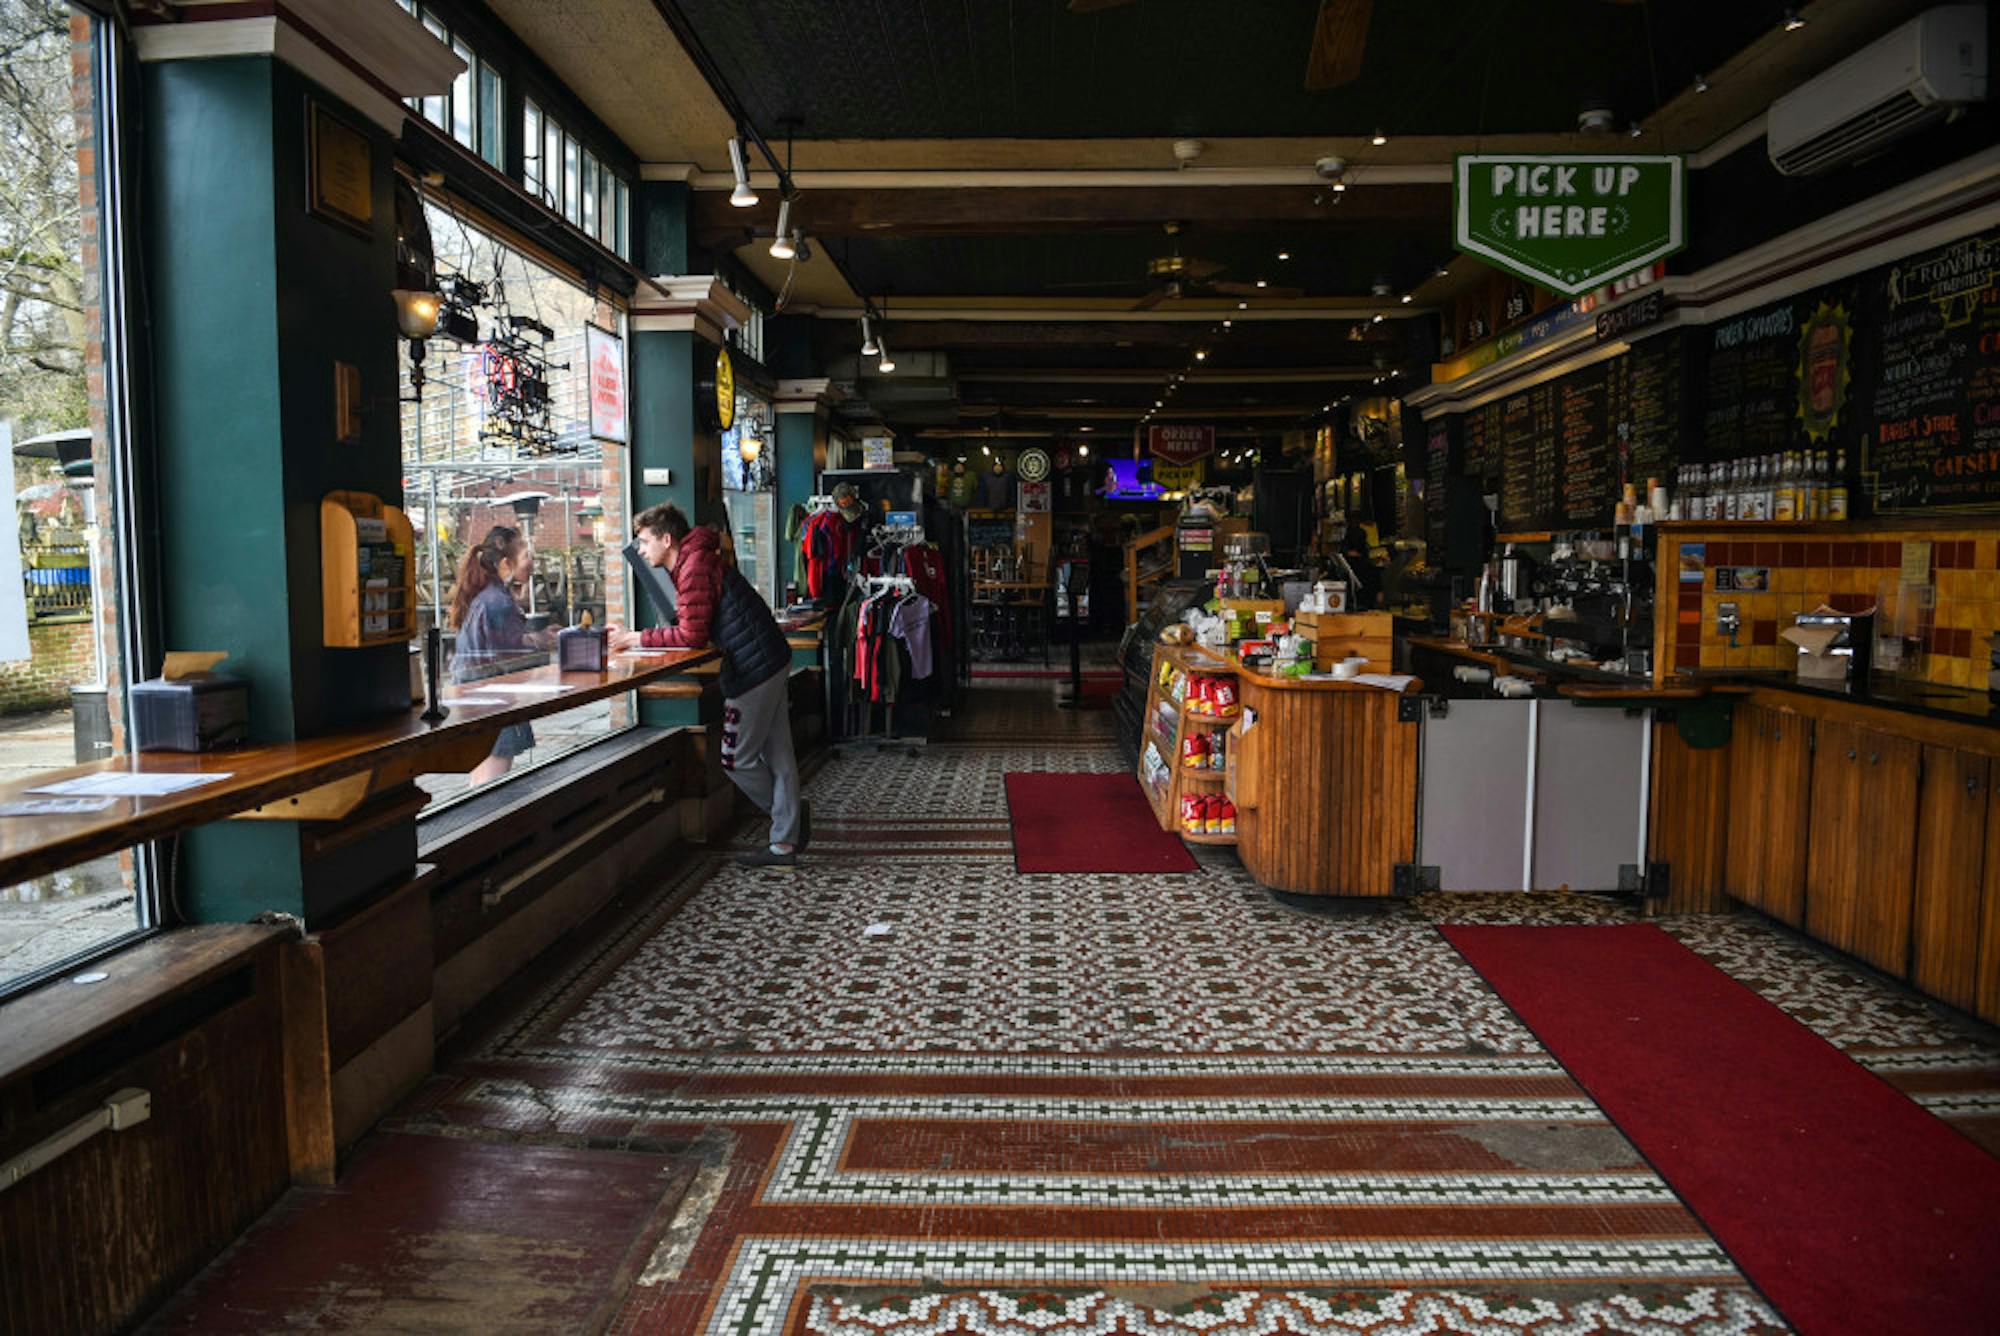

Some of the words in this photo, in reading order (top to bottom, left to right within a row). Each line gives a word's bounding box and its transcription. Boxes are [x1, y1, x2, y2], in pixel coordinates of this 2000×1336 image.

[1491, 164, 1578, 197] PICK
[1592, 166, 1641, 197] UP
[1516, 205, 1609, 239] HERE
[1161, 428, 1203, 440] ORDER
[1167, 441, 1199, 452] HERE
